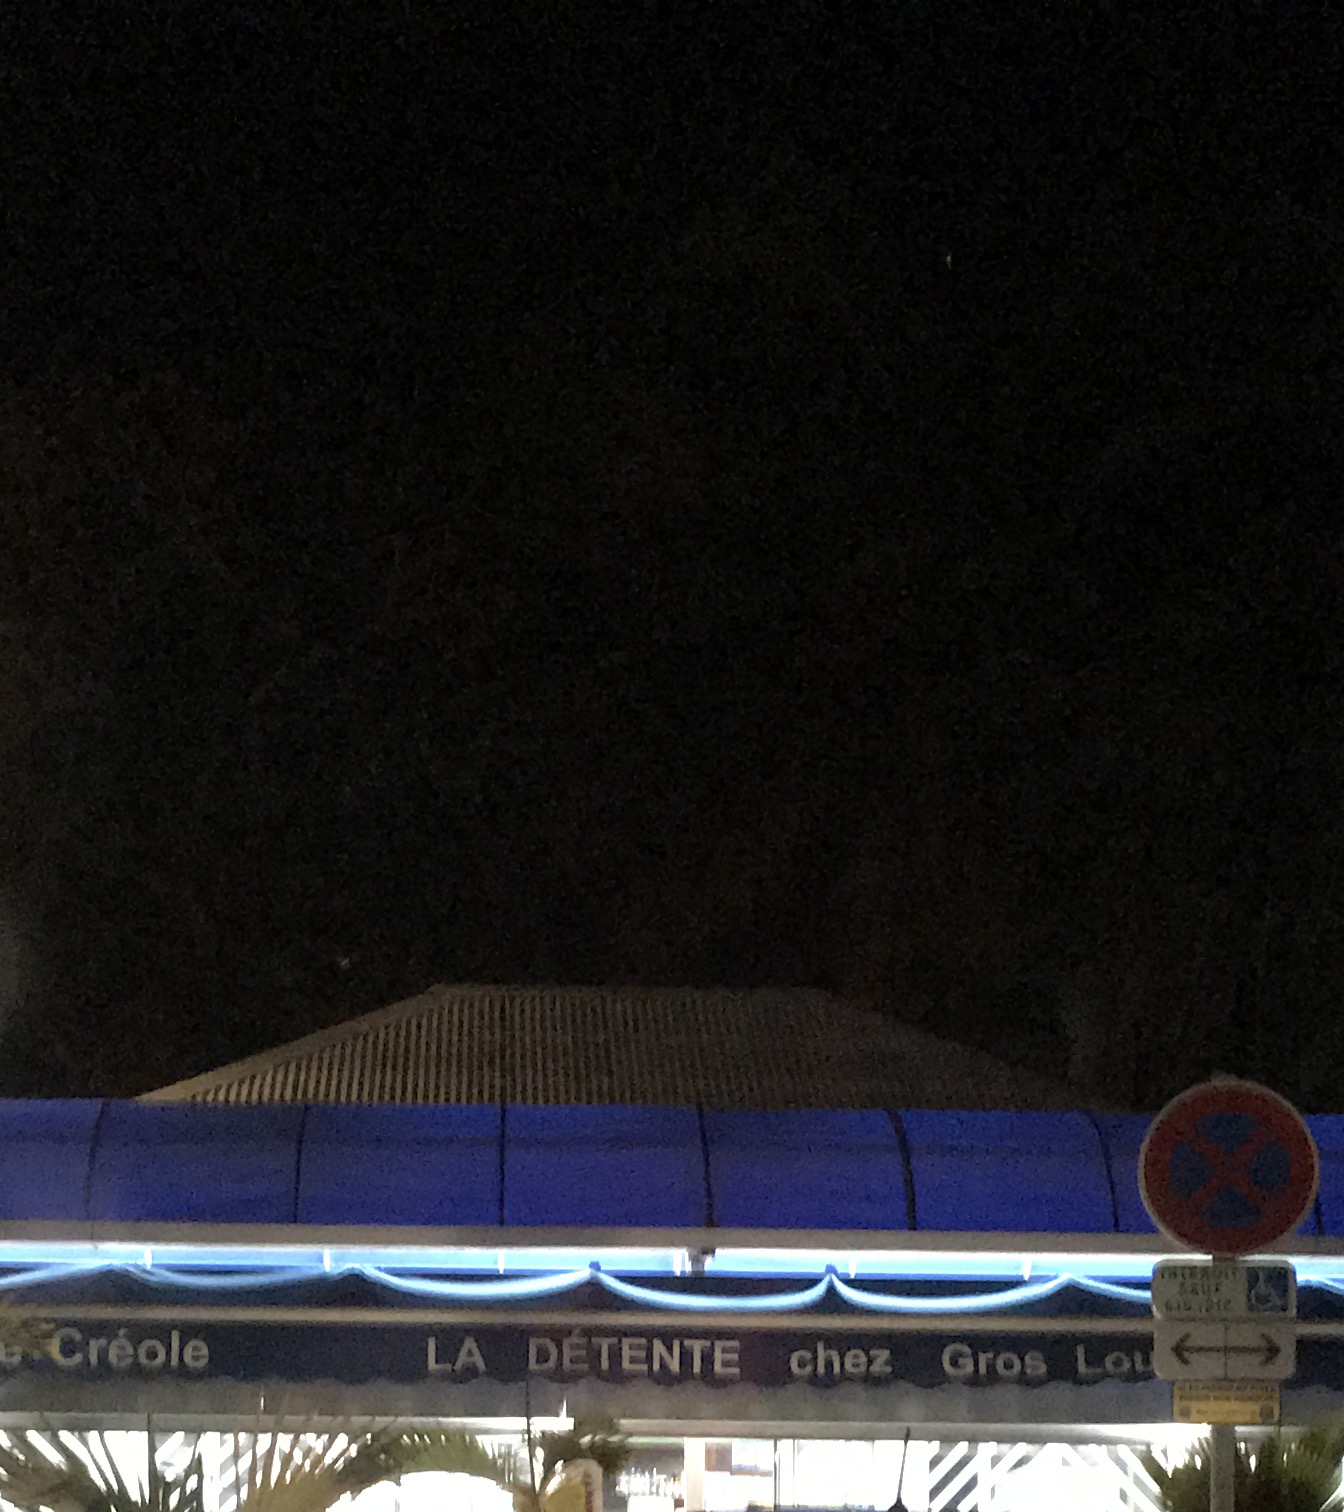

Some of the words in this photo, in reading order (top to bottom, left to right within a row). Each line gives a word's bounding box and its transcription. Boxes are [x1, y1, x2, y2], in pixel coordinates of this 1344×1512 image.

[52, 1326, 209, 1369] Créole
[427, 1336, 488, 1373] LA
[527, 1328, 741, 1376] DÉTENTE
[789, 1341, 894, 1376] chez
[941, 1343, 1047, 1377] Gros
